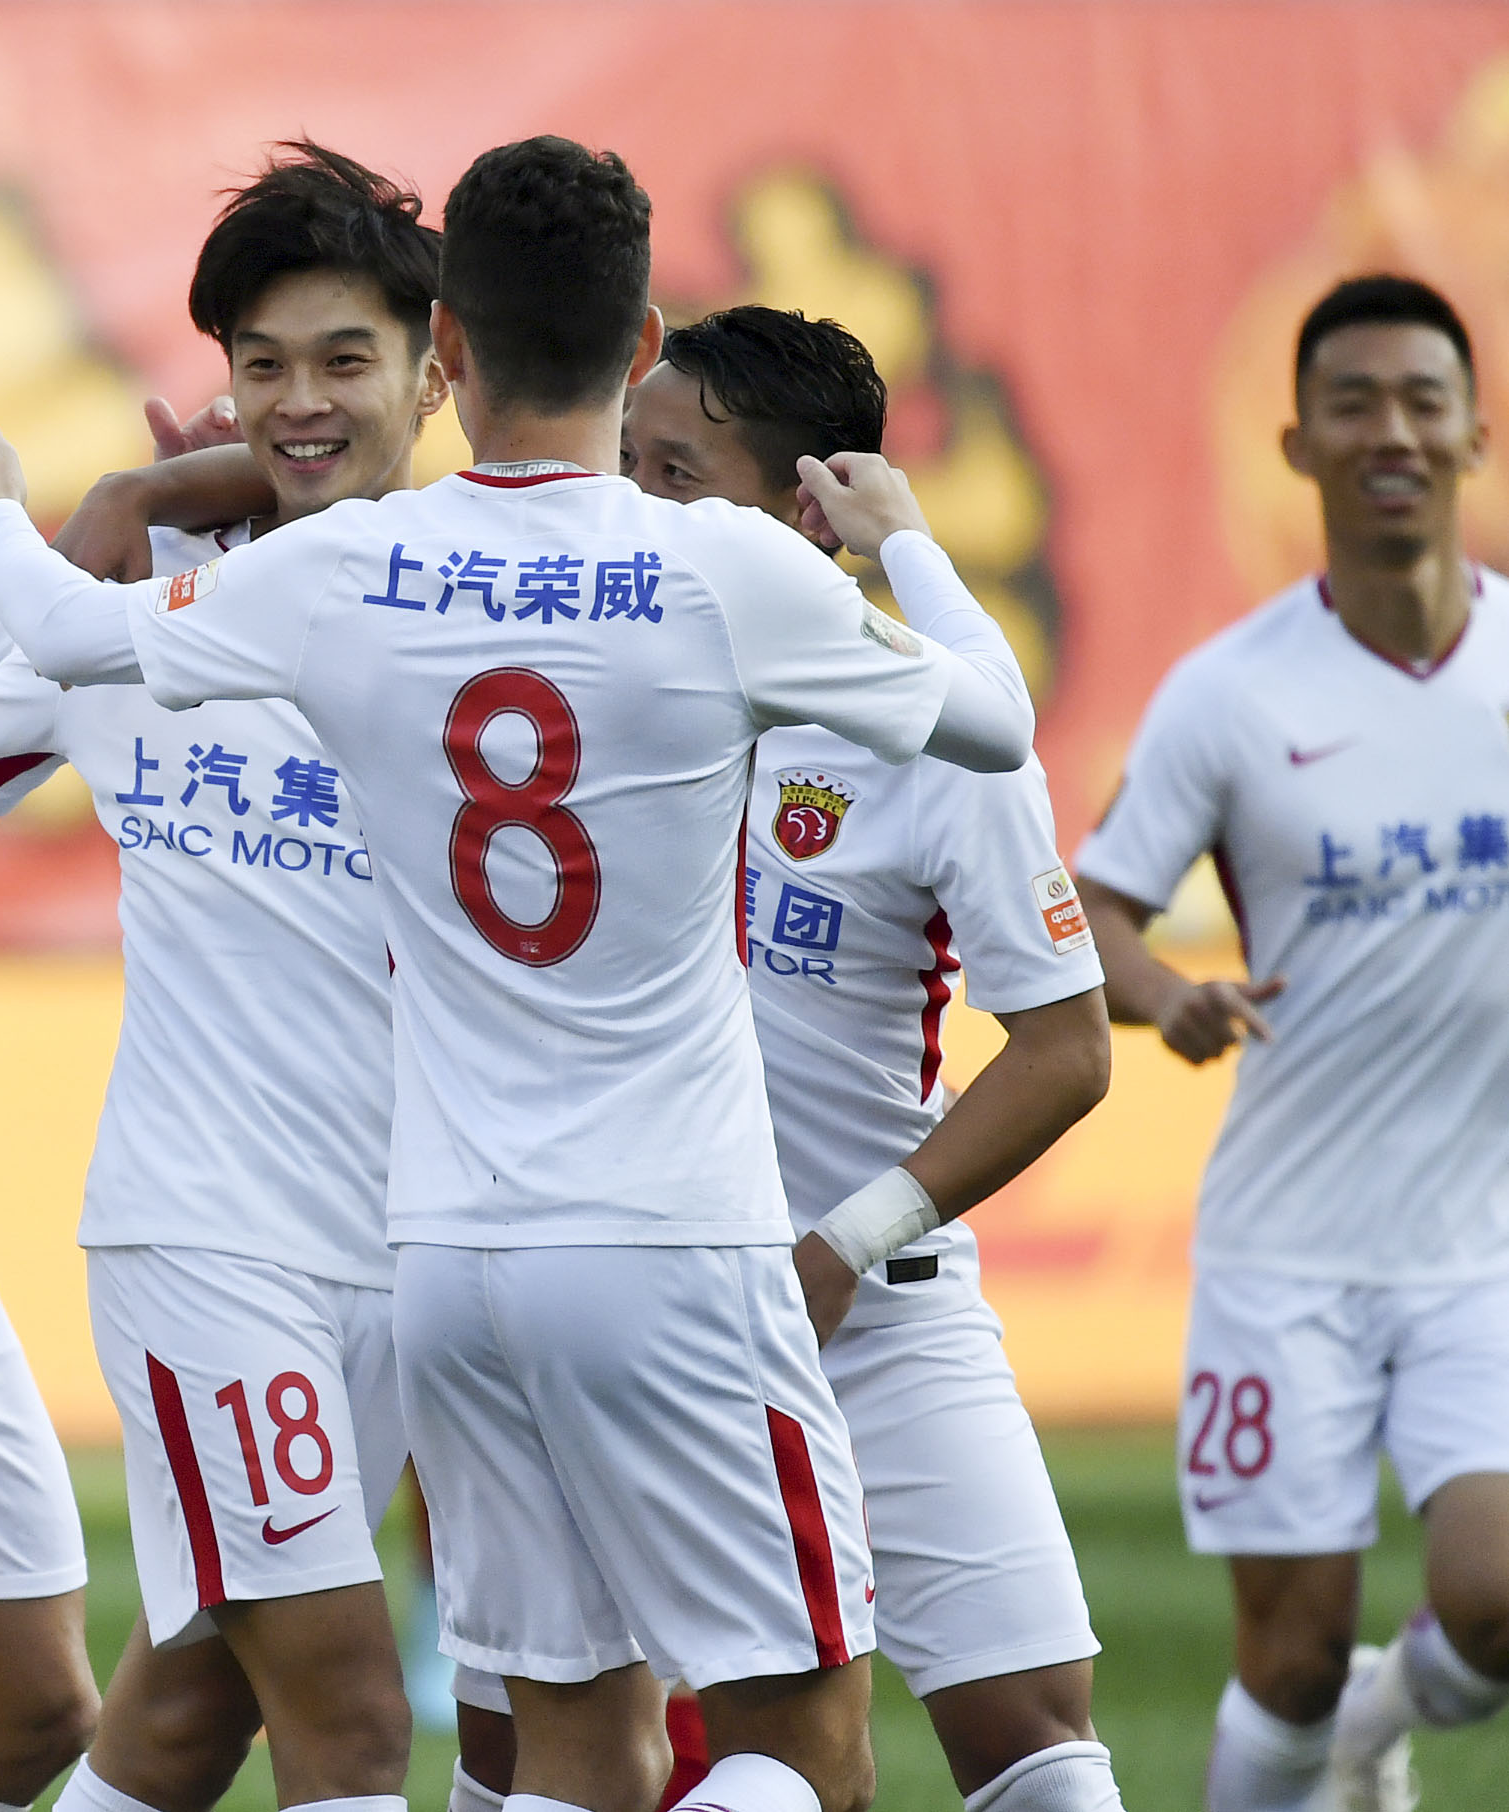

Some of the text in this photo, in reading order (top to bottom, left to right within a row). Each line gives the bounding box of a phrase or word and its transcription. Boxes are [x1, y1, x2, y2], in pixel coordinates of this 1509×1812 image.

[491, 463, 565, 478] NIKE PRO
[363, 542, 664, 625] 上汽荣威
[115, 737, 364, 837] 上汽集
[443, 667, 602, 968] 8
[119, 816, 373, 882] SAIC MOTO
[215, 1370, 334, 1507] 18
[1188, 1370, 1274, 1482] 28
